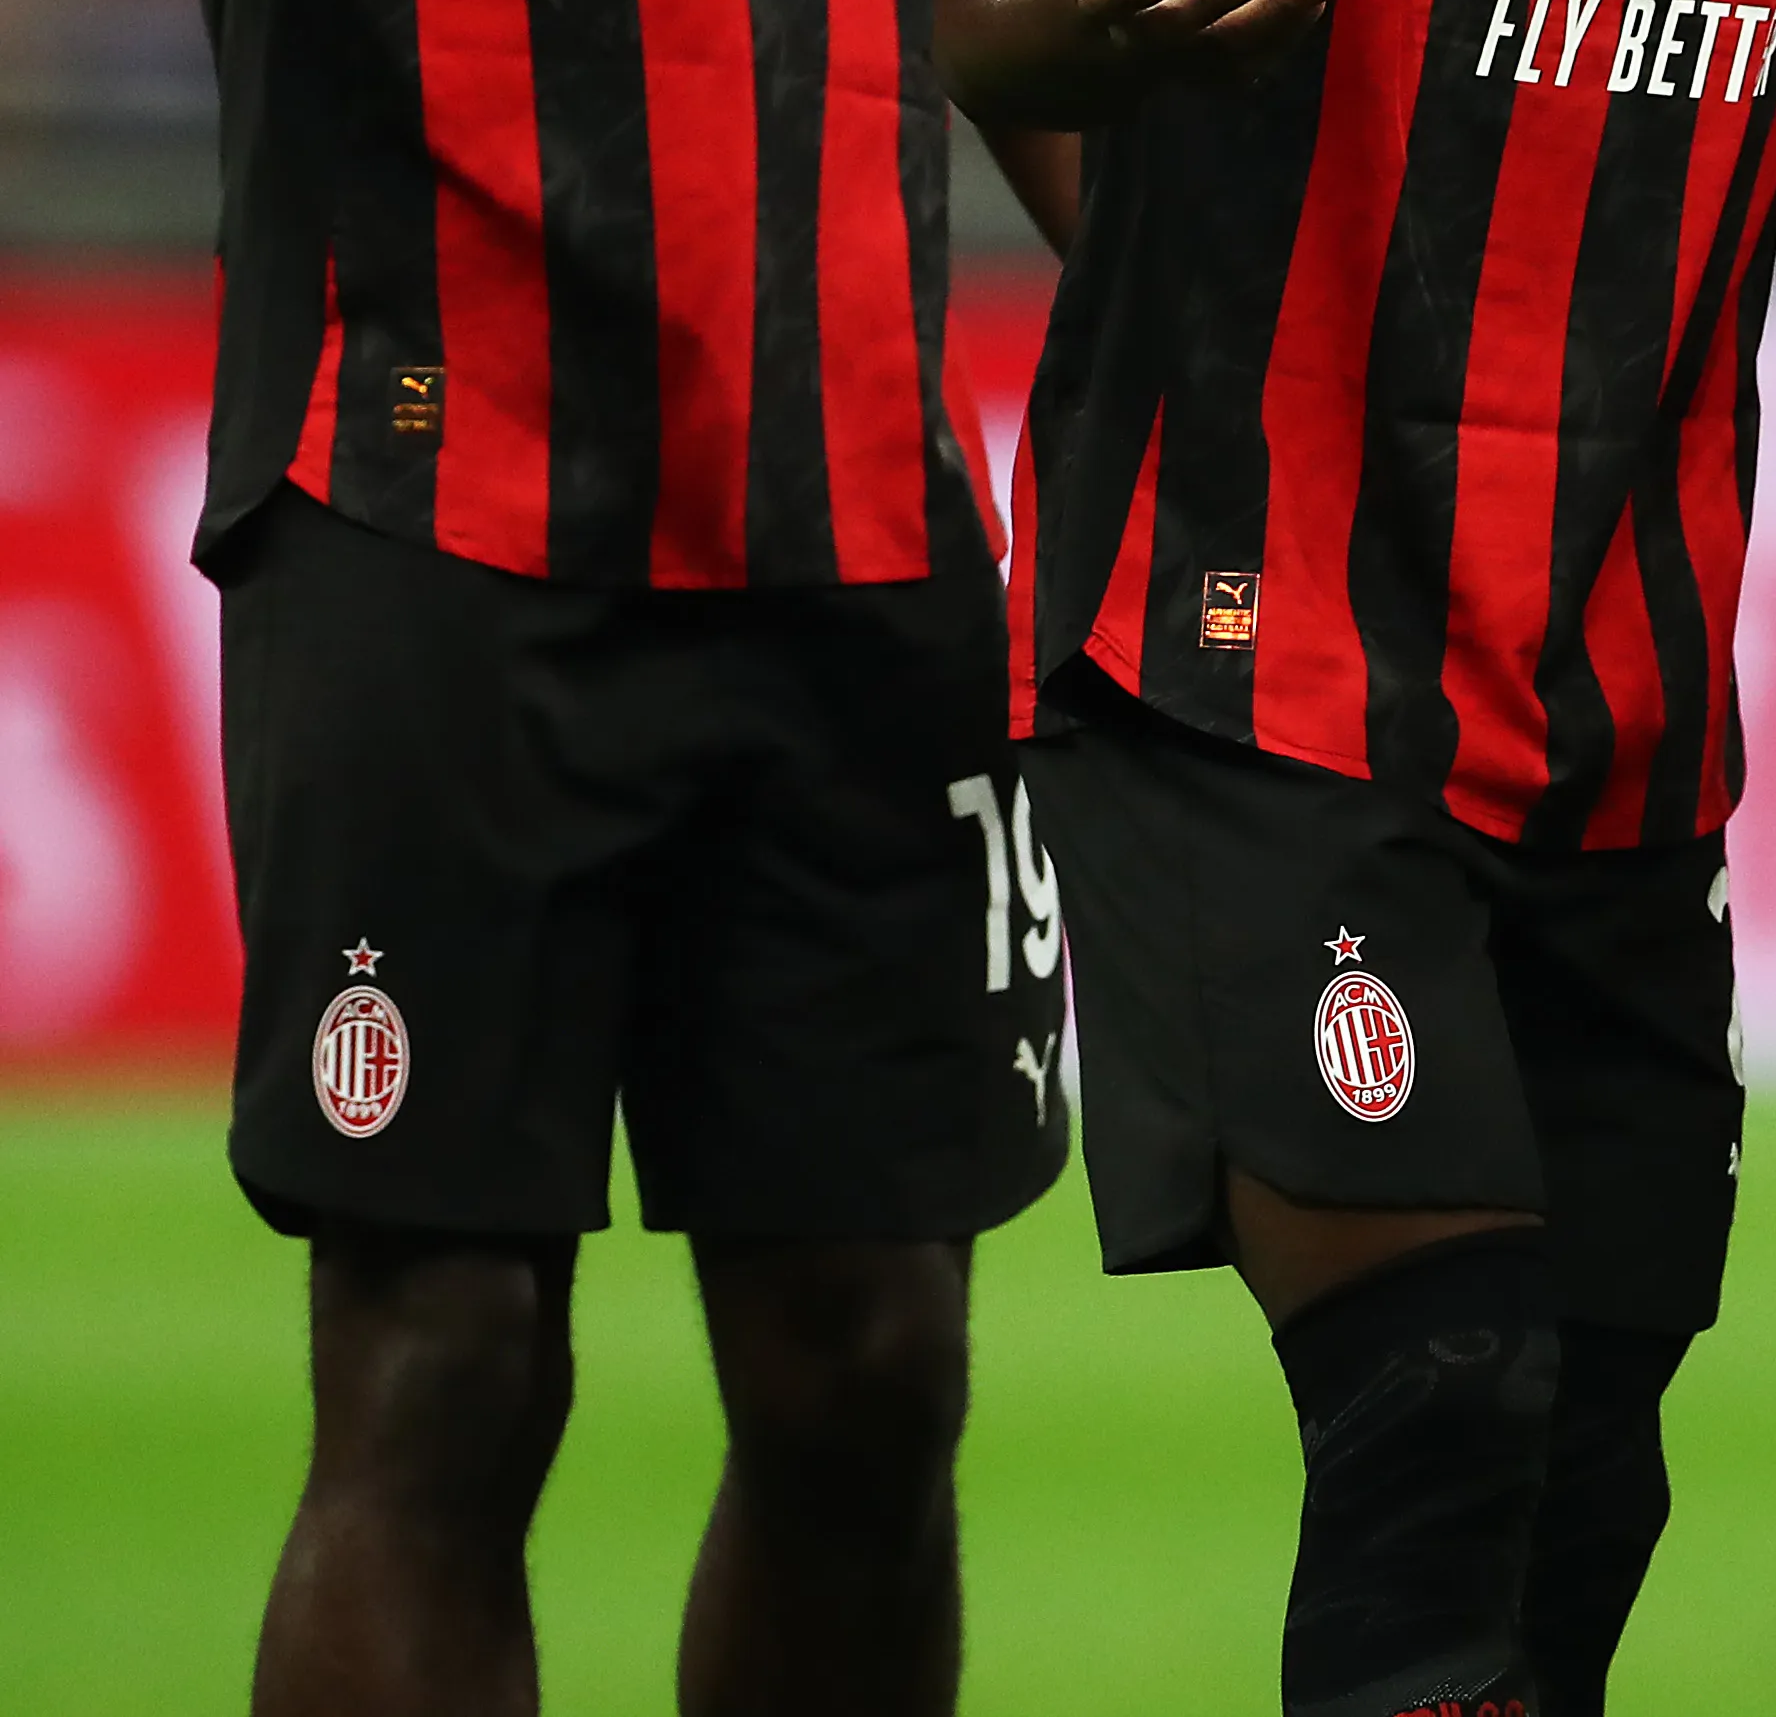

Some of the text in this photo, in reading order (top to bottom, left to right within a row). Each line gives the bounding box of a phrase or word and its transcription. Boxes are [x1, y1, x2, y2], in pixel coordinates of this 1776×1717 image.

[946, 772, 1062, 993] 19
[1330, 983, 1384, 1018] ACM
[1351, 1082, 1398, 1105] 1899
